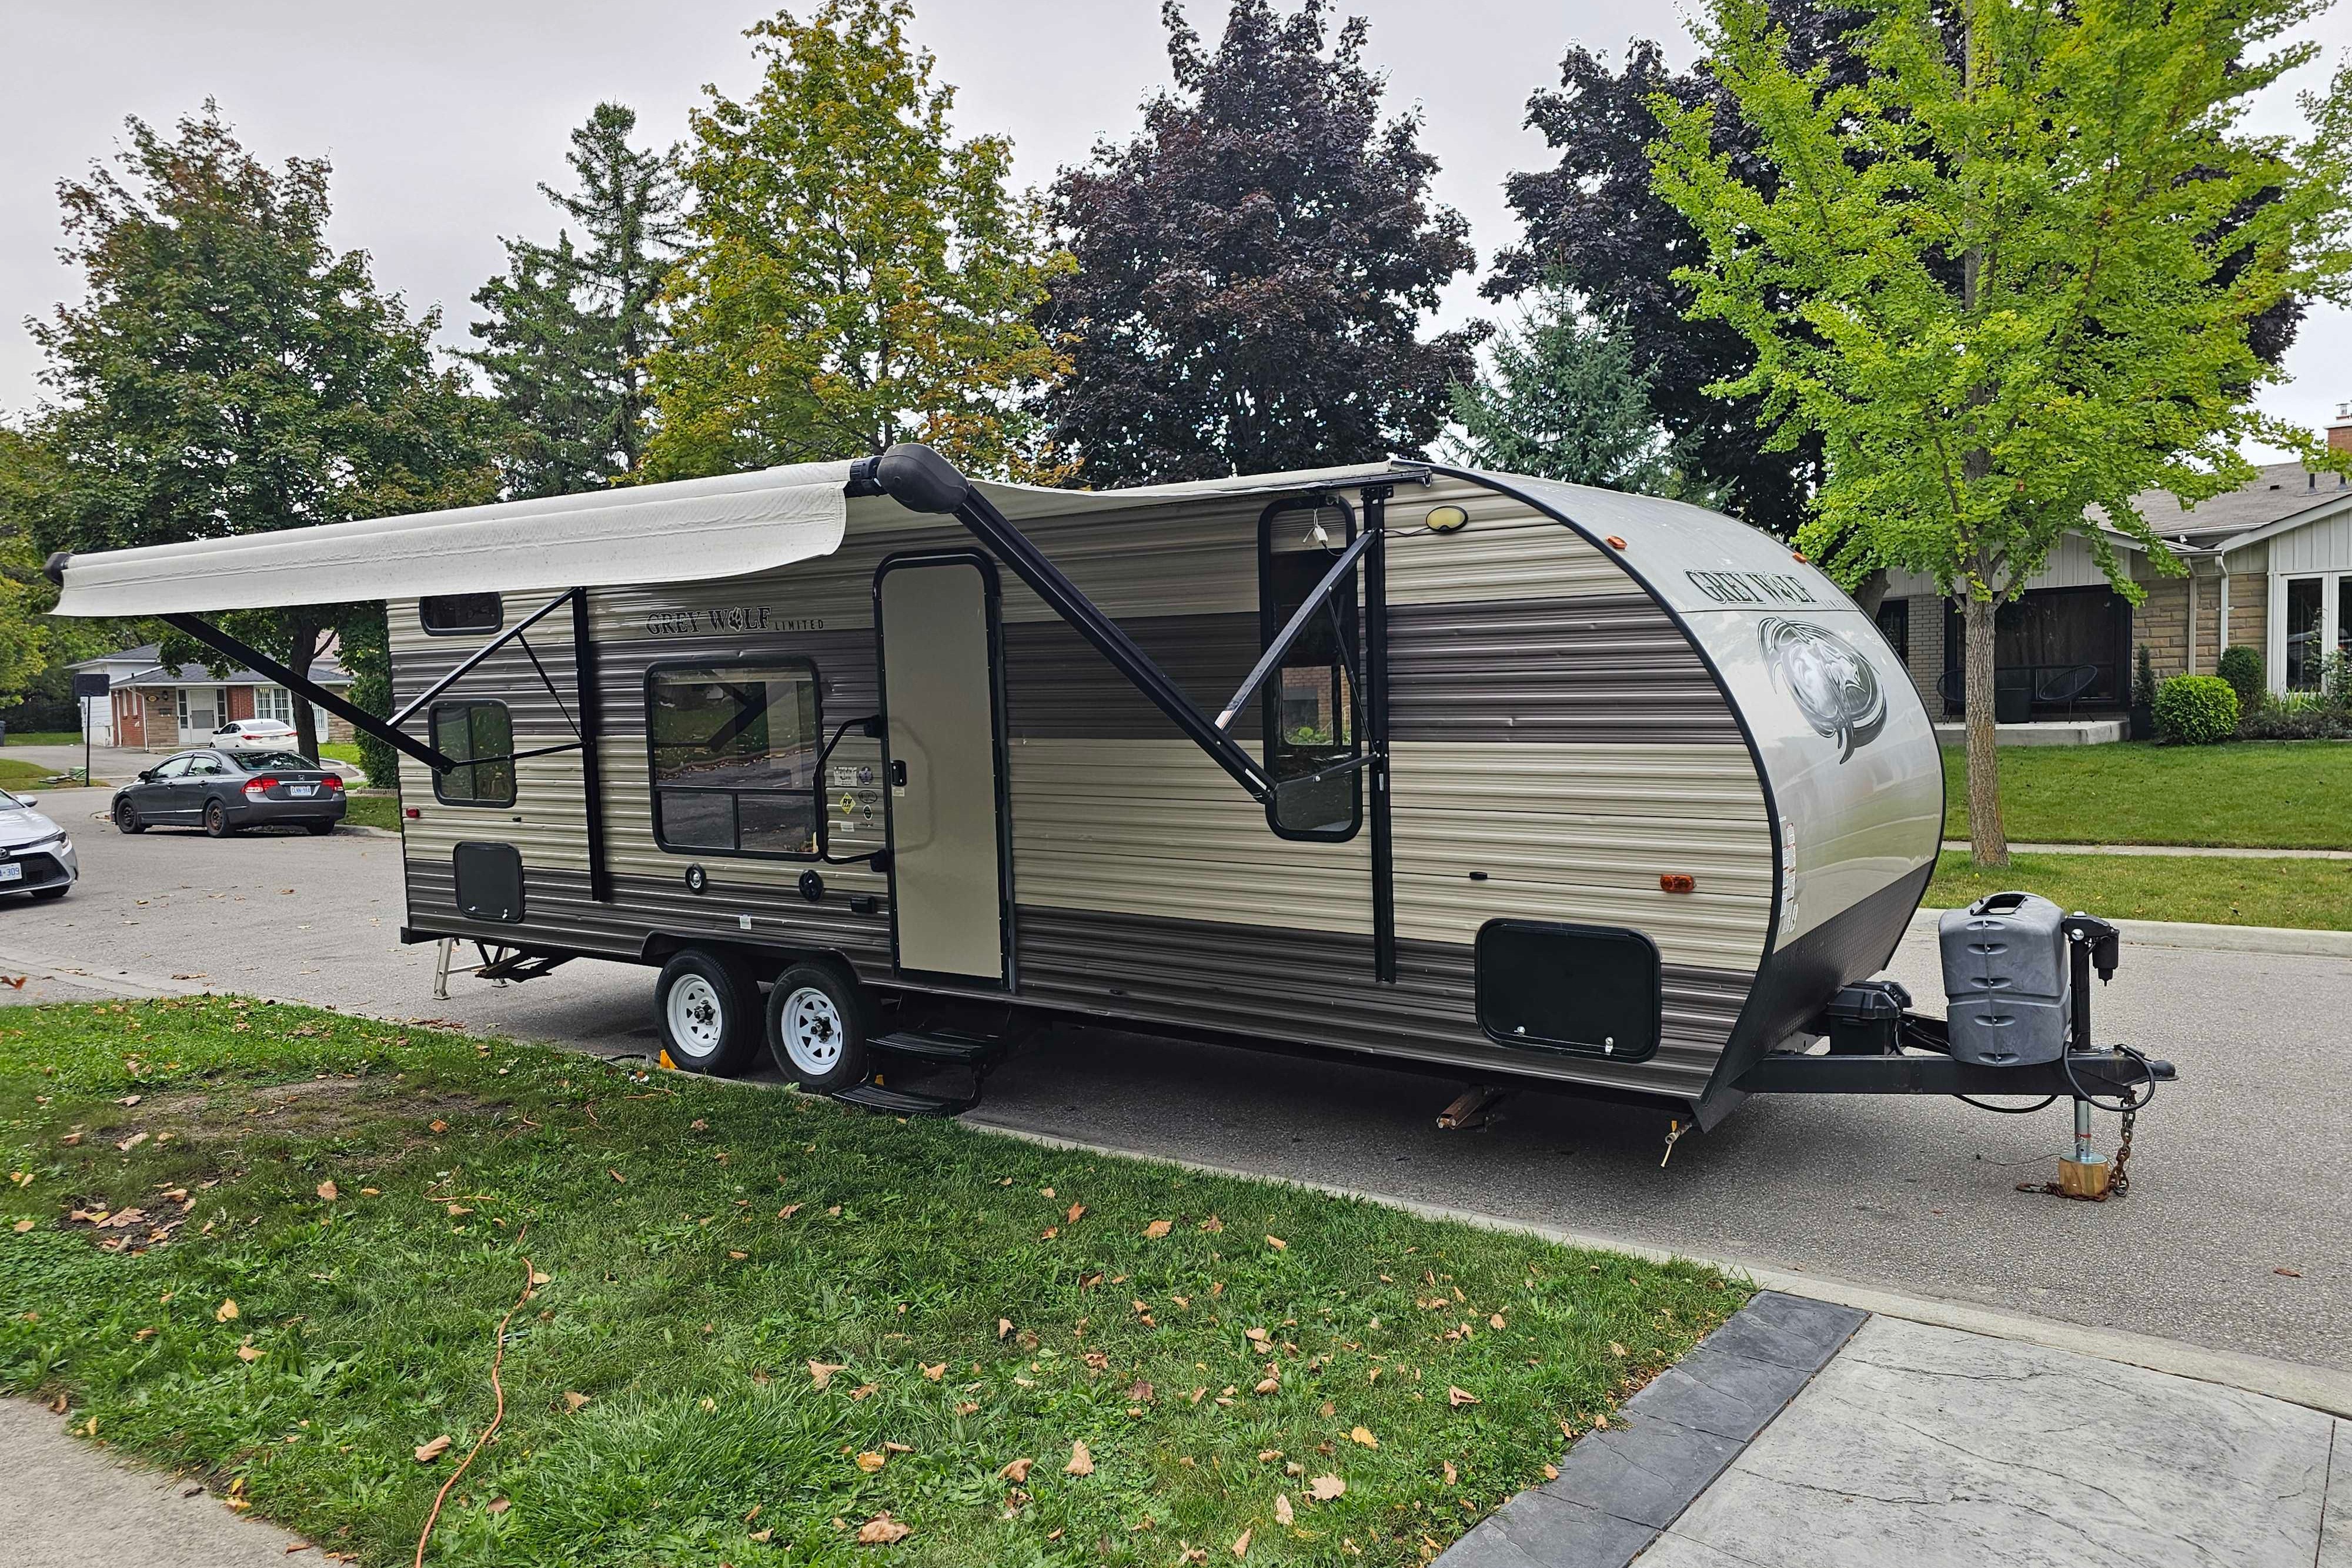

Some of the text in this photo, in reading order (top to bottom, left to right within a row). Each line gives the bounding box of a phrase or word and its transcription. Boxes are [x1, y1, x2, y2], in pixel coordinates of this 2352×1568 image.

[1683, 569, 1766, 604] GREY
[646, 606, 823, 635] GREY WOLF LIMITED
